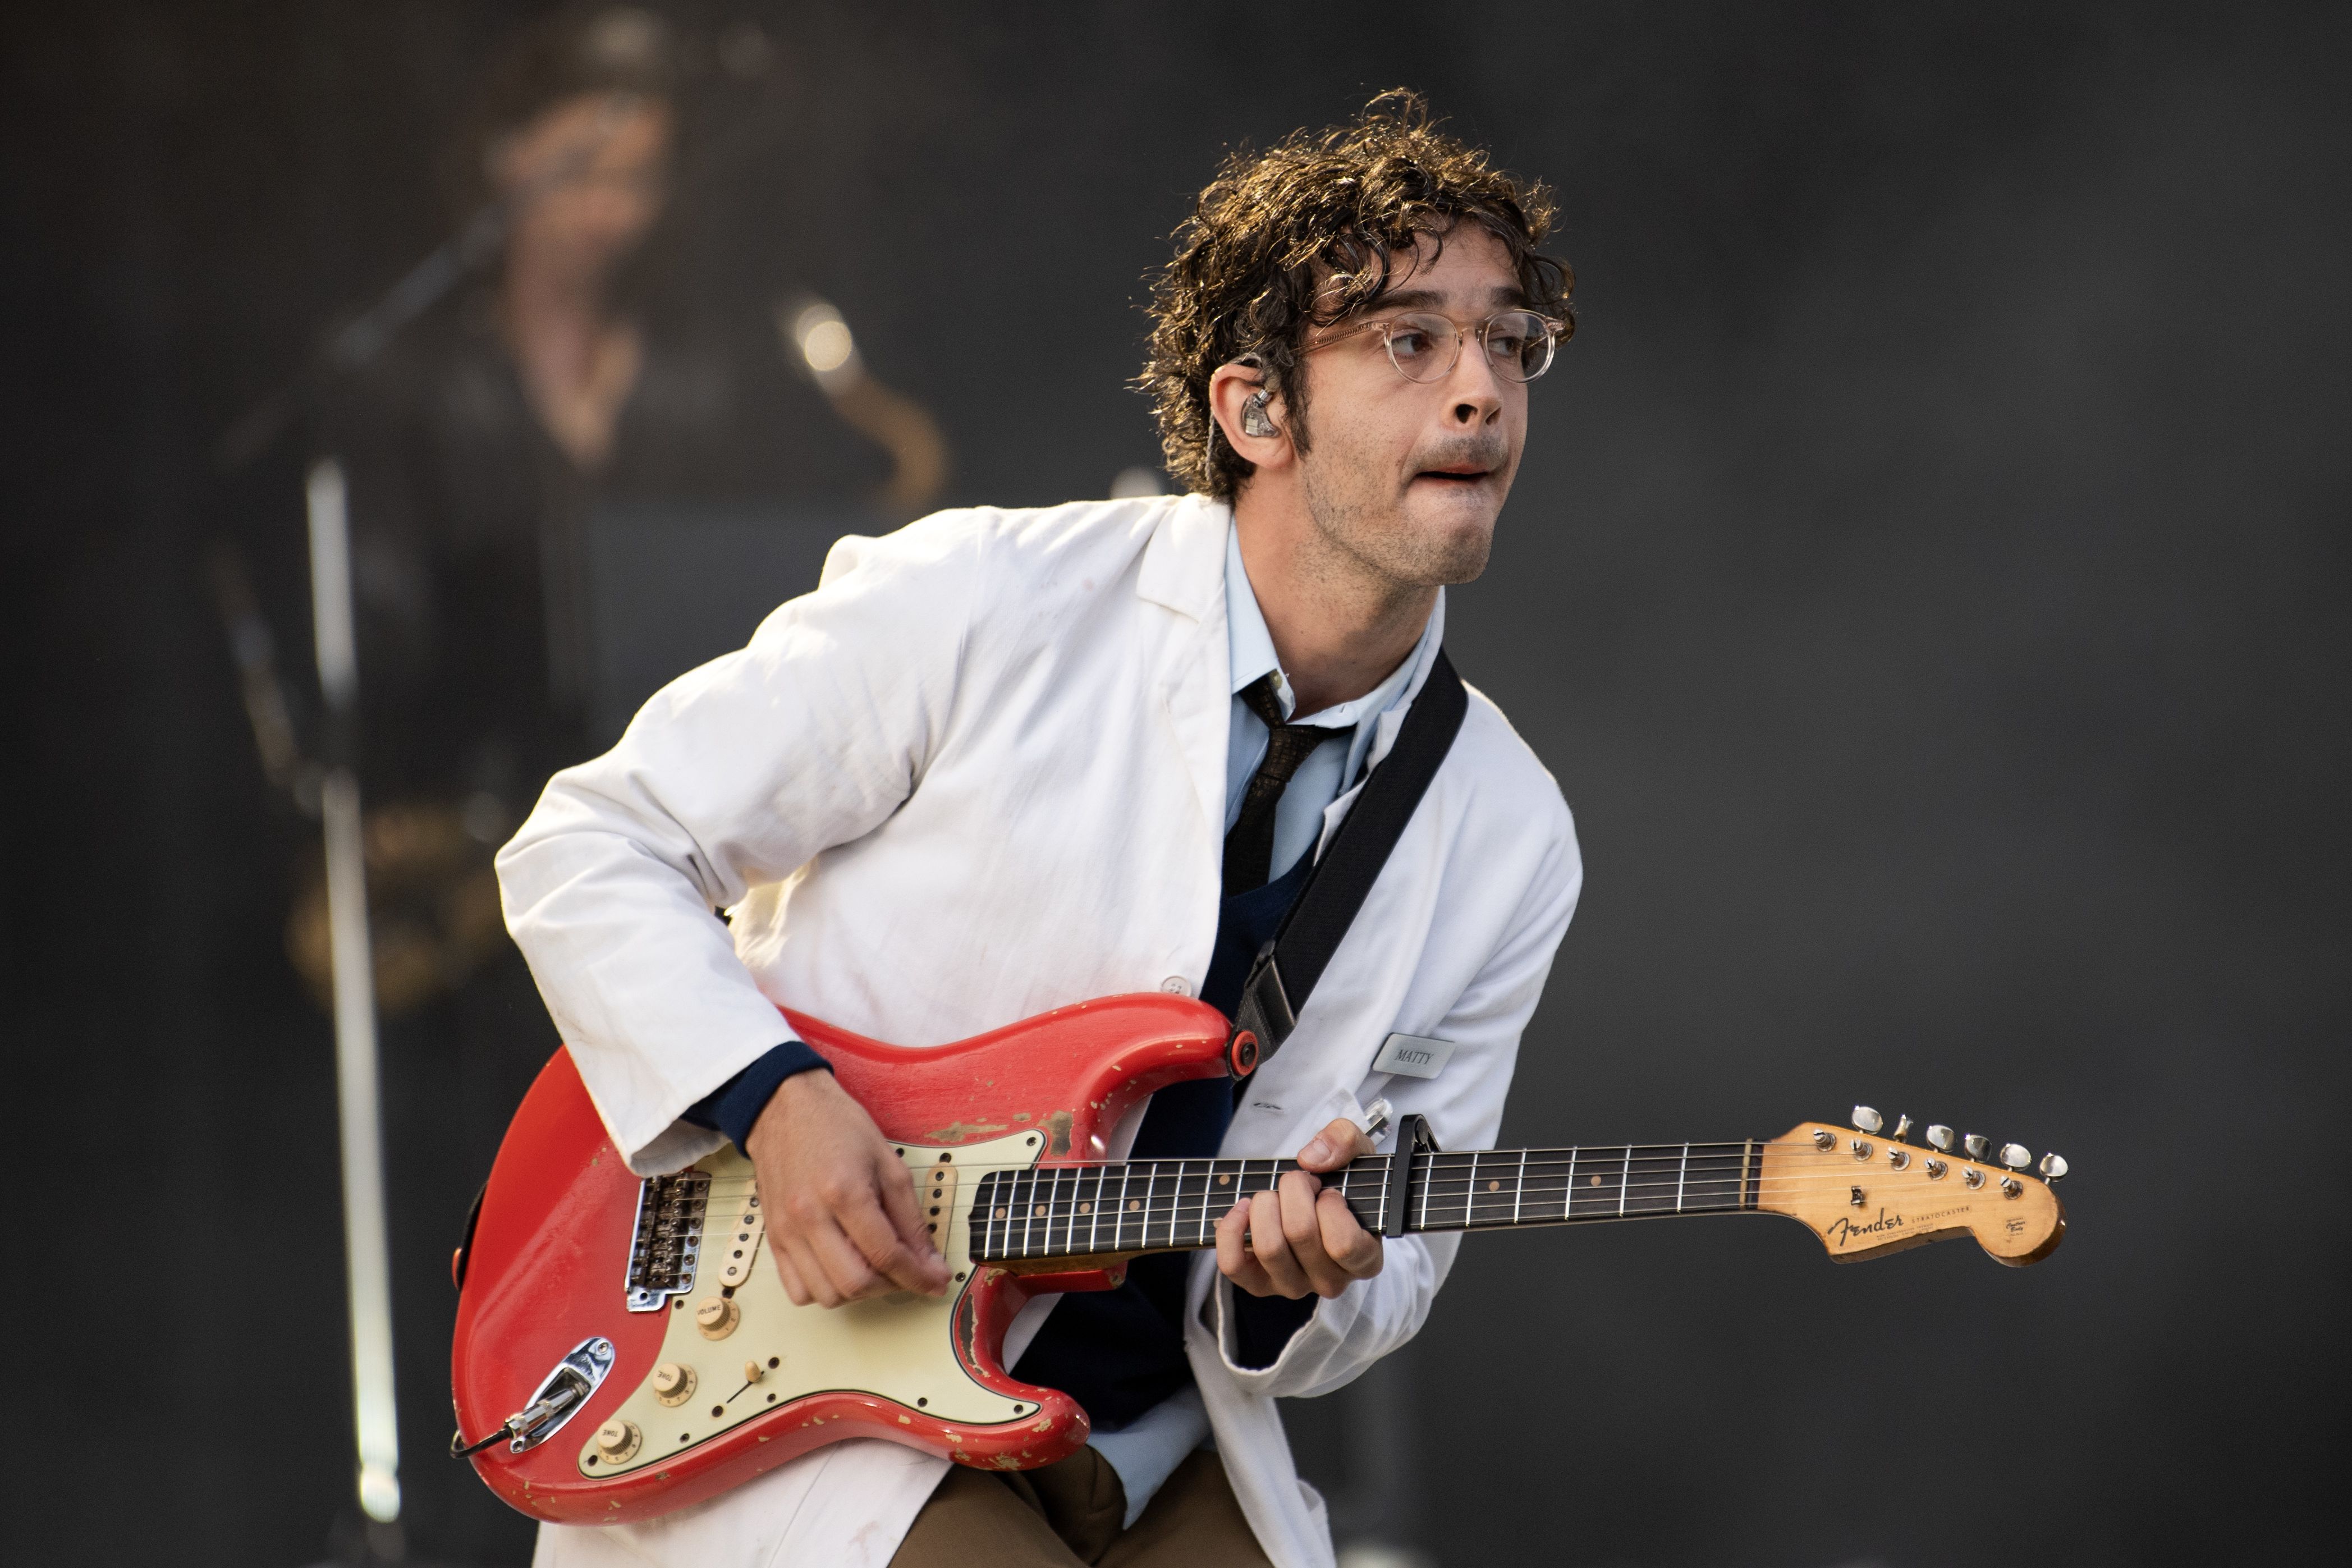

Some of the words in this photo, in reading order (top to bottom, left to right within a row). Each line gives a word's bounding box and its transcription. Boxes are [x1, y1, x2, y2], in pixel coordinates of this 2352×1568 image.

[1394, 1049, 1434, 1065] MATTY
[1827, 1207, 1904, 1247] Fender
[1911, 1206, 1970, 1224] STRATOCASTER
[696, 1304, 722, 1315] VOLUME
[657, 1370, 673, 1382] TONE
